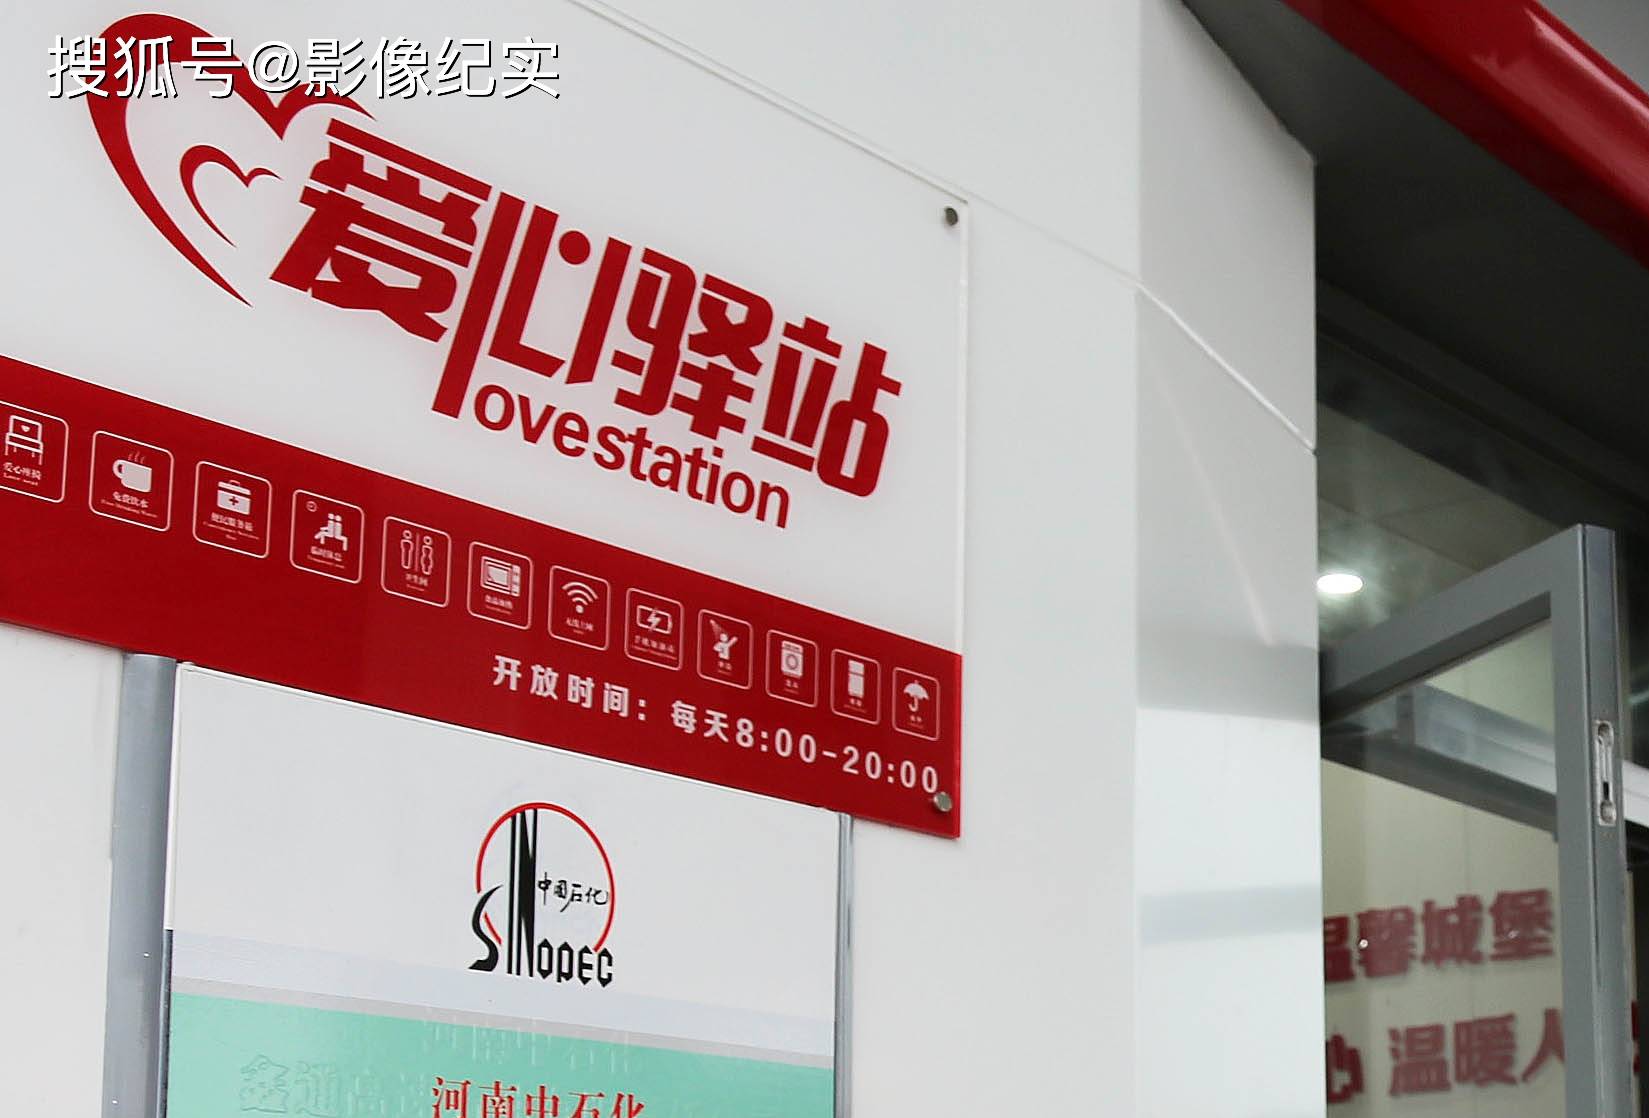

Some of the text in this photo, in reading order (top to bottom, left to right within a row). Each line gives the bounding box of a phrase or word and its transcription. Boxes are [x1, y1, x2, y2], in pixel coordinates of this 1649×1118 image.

[269, 117, 902, 498] 爱心驿站
[468, 808, 613, 988] SINOPEC
[537, 871, 609, 913] 中国石化
